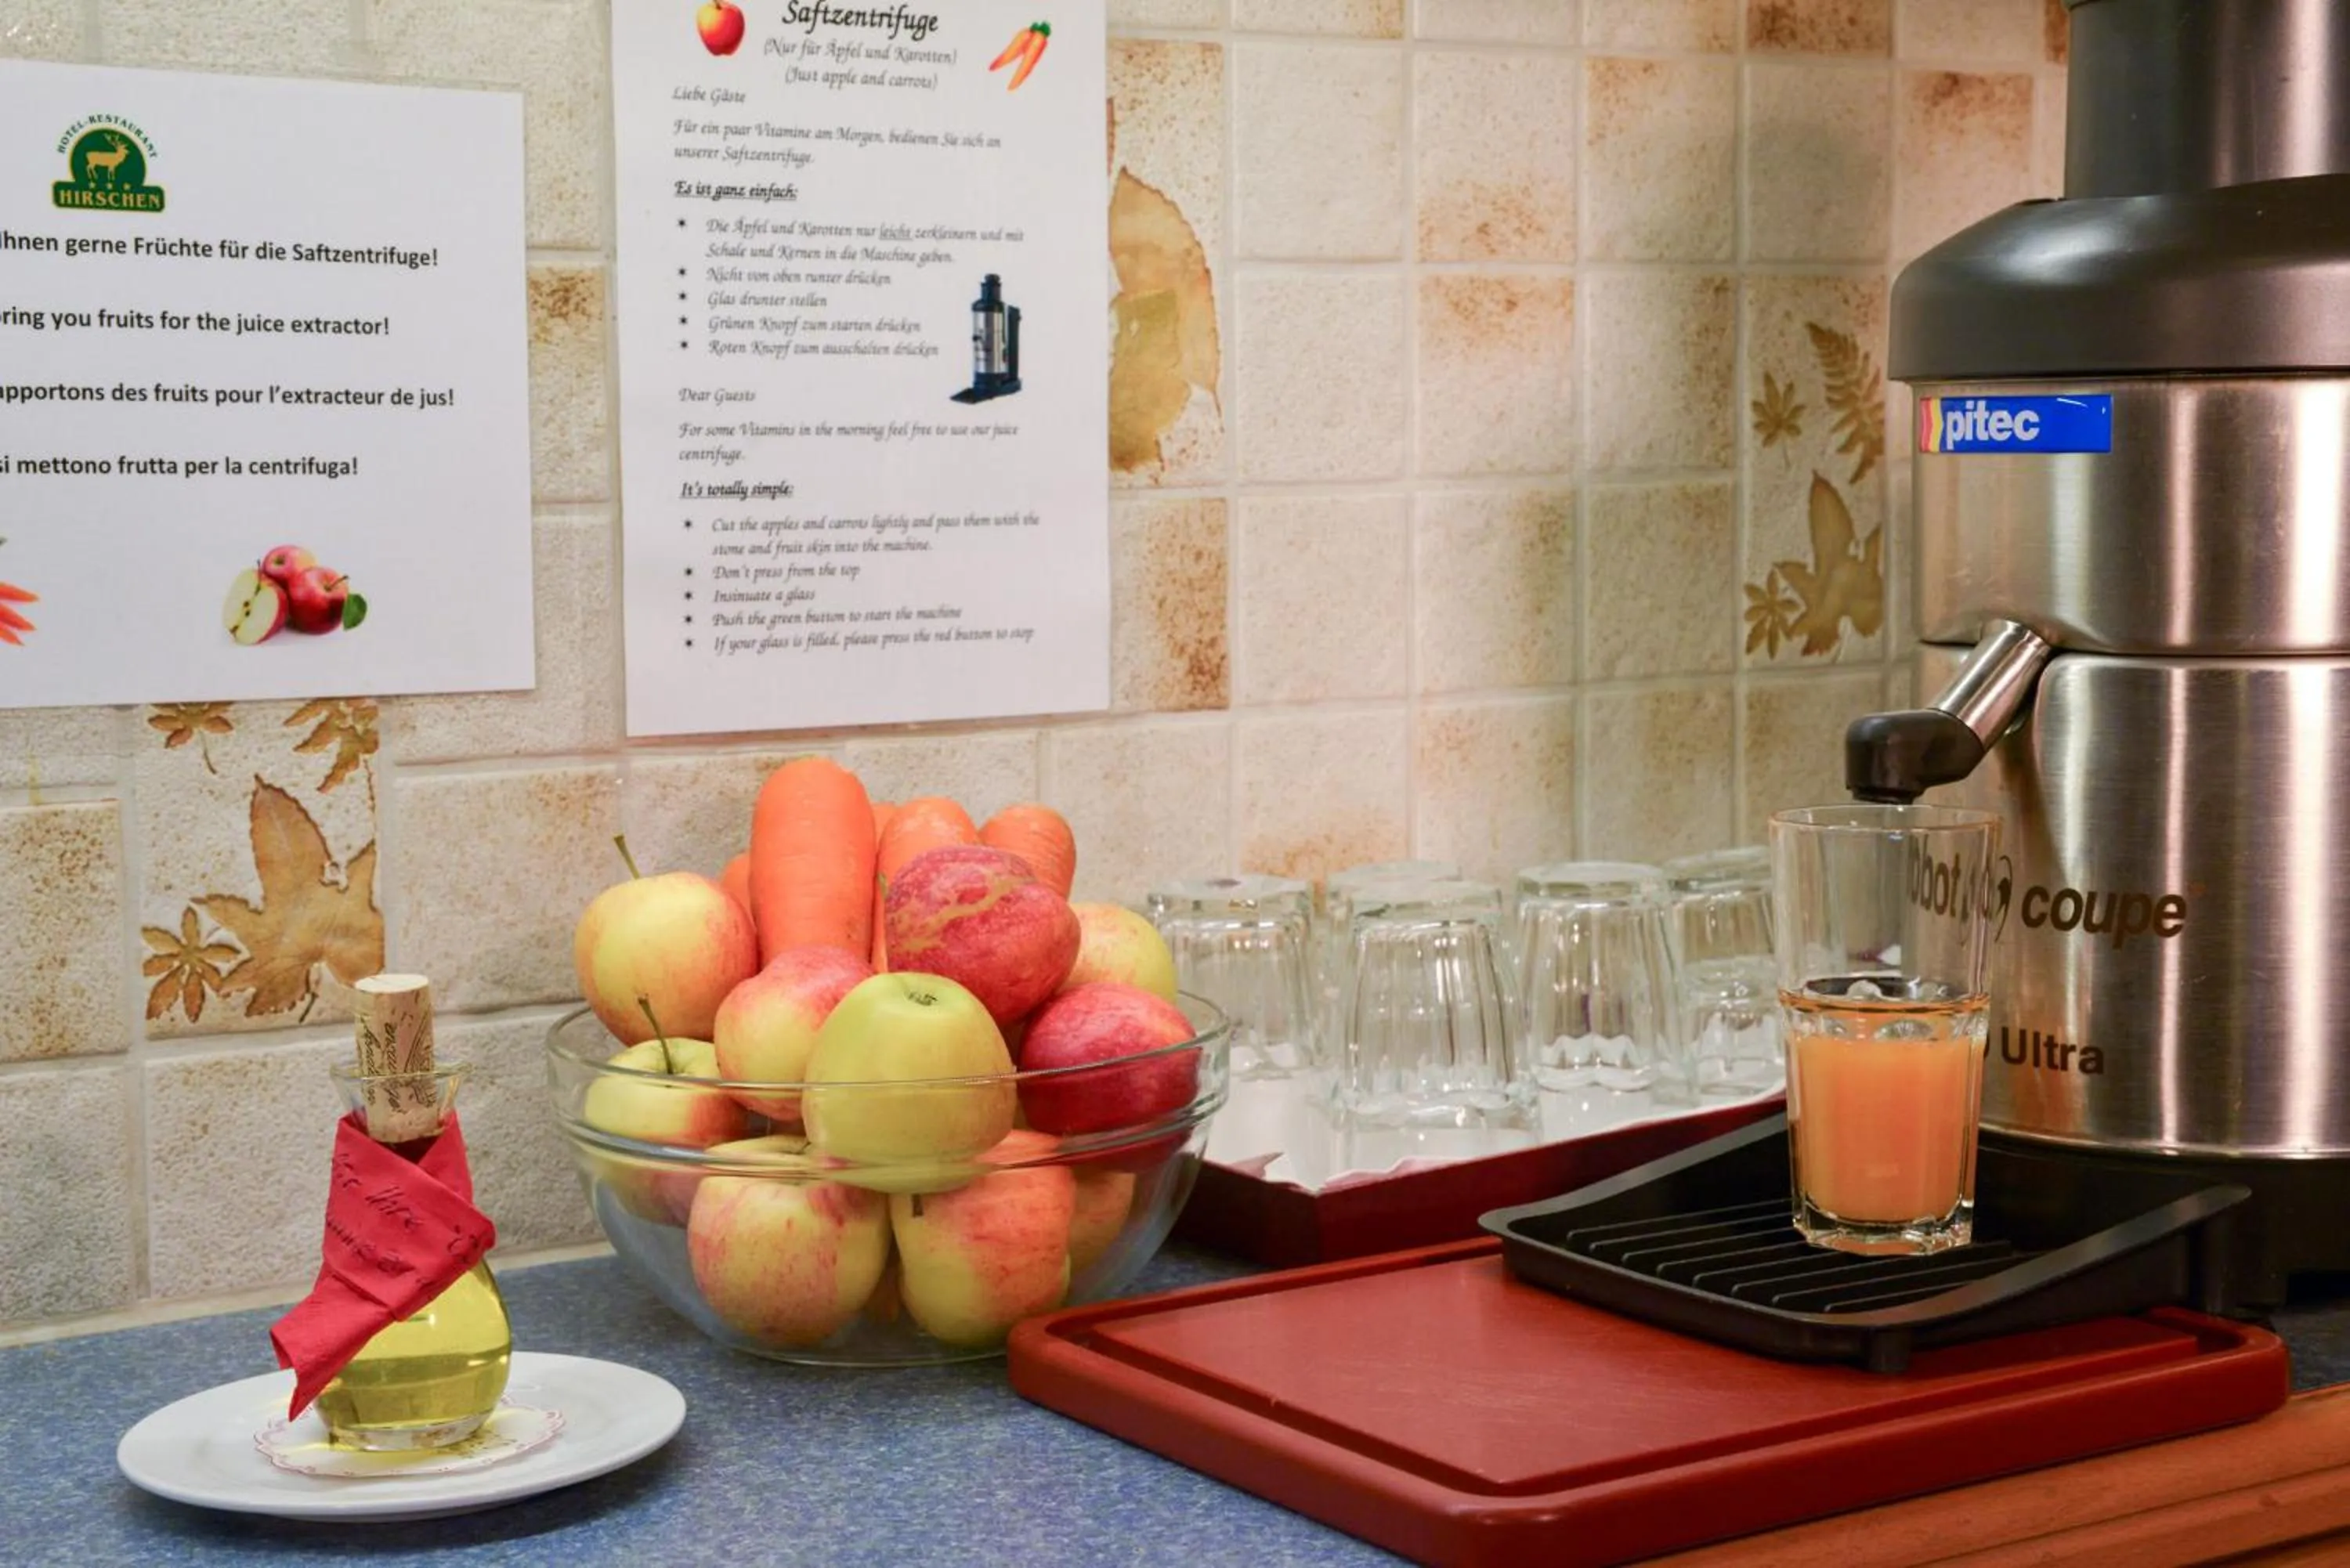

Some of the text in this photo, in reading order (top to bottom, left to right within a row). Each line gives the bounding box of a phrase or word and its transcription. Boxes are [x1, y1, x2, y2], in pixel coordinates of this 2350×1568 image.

[782, 0, 938, 41] Saftzentrifuge
[763, 38, 957, 65] (Nur für Äpfel und Karotten)
[785, 66, 938, 91] (Just apple and carrots)
[672, 85, 746, 107] Liebe Gäste
[56, 114, 158, 159] HOTEL-RESTAURANT
[674, 119, 699, 135] Für
[701, 122, 720, 135] ein
[723, 124, 752, 141] paar
[754, 122, 811, 139] Vitamine
[815, 129, 833, 139] am
[888, 129, 938, 145] bedienen
[987, 138, 1001, 147] an
[674, 143, 815, 169] unserer Saftzentrifuge.
[60, 190, 161, 209] HIRSCHEN
[674, 180, 798, 202] Es ist ganz einfach:
[706, 217, 1024, 240] Die Äpfel und Karotten nur leicht zerkleinern und mit
[66, 238, 127, 256] gerne
[134, 237, 213, 257] Früchte
[219, 240, 249, 258] für
[255, 241, 286, 260] die
[293, 244, 437, 269] Saftzentrifuge!
[705, 242, 747, 258] Schale
[750, 244, 776, 258] und
[778, 245, 821, 261] Kernen
[825, 247, 837, 260] in
[840, 245, 858, 260] die
[862, 247, 916, 262] Maschine
[705, 266, 891, 286] Nicht von oben runter drücken
[707, 291, 827, 309] Glas drunter stellen
[0, 306, 389, 335] ring you fruits for the juice extractor!
[708, 316, 920, 336] Grünen Knopf zum starten drücken
[708, 339, 938, 359] Roten Knopf zum ausschalten drücken
[111, 382, 147, 401] des
[154, 383, 208, 403] fruits
[215, 389, 263, 406] pour
[269, 385, 385, 405] l'extracteur
[391, 388, 414, 405] de
[420, 388, 454, 410] jus!
[678, 388, 757, 406] Dear Guests
[678, 421, 703, 439] For
[705, 425, 736, 436] some
[739, 421, 794, 436] Vitamins
[797, 422, 811, 436] in
[815, 421, 833, 436] the
[837, 423, 884, 443] morning
[885, 420, 909, 443] feel
[909, 420, 932, 443] free
[935, 425, 948, 435] to
[950, 425, 968, 436] use
[971, 425, 990, 436] our
[1946, 400, 2040, 450] pitec
[678, 445, 746, 466] centrifuge.
[17, 457, 111, 474] mettono
[118, 456, 178, 474] frutta
[185, 461, 219, 479] per
[226, 457, 242, 475] la
[249, 457, 357, 479] centrifuga!
[680, 479, 794, 501] It's totally simple:
[711, 517, 736, 532] Cut
[739, 515, 758, 531] the
[761, 515, 799, 537] apples
[803, 515, 827, 529] and
[871, 513, 910, 535] lightly
[912, 511, 935, 528] and
[964, 511, 991, 527] them
[994, 511, 1020, 526] with
[1023, 510, 1040, 526] the
[711, 544, 745, 555] stone
[747, 539, 773, 555] and
[772, 539, 804, 560] fruit
[806, 538, 831, 556] skin
[834, 540, 859, 553] into
[862, 537, 880, 552] the
[752, 567, 783, 584] press
[783, 562, 815, 583] from
[818, 562, 837, 577] the
[840, 565, 861, 583] top
[713, 586, 815, 608] Insinuate a glass
[711, 602, 963, 631] Push the green button to start the machine
[713, 633, 728, 657] If
[728, 638, 756, 656] your
[756, 634, 790, 655] glass
[792, 635, 802, 649] is
[843, 630, 878, 652] please
[882, 632, 909, 650] press
[913, 627, 931, 643] the
[935, 627, 953, 641] red
[954, 626, 992, 641] button
[996, 628, 1008, 640] to
[1010, 627, 1034, 645] stop
[2022, 885, 2187, 948] coupe
[2001, 1027, 2104, 1075] Ultra
